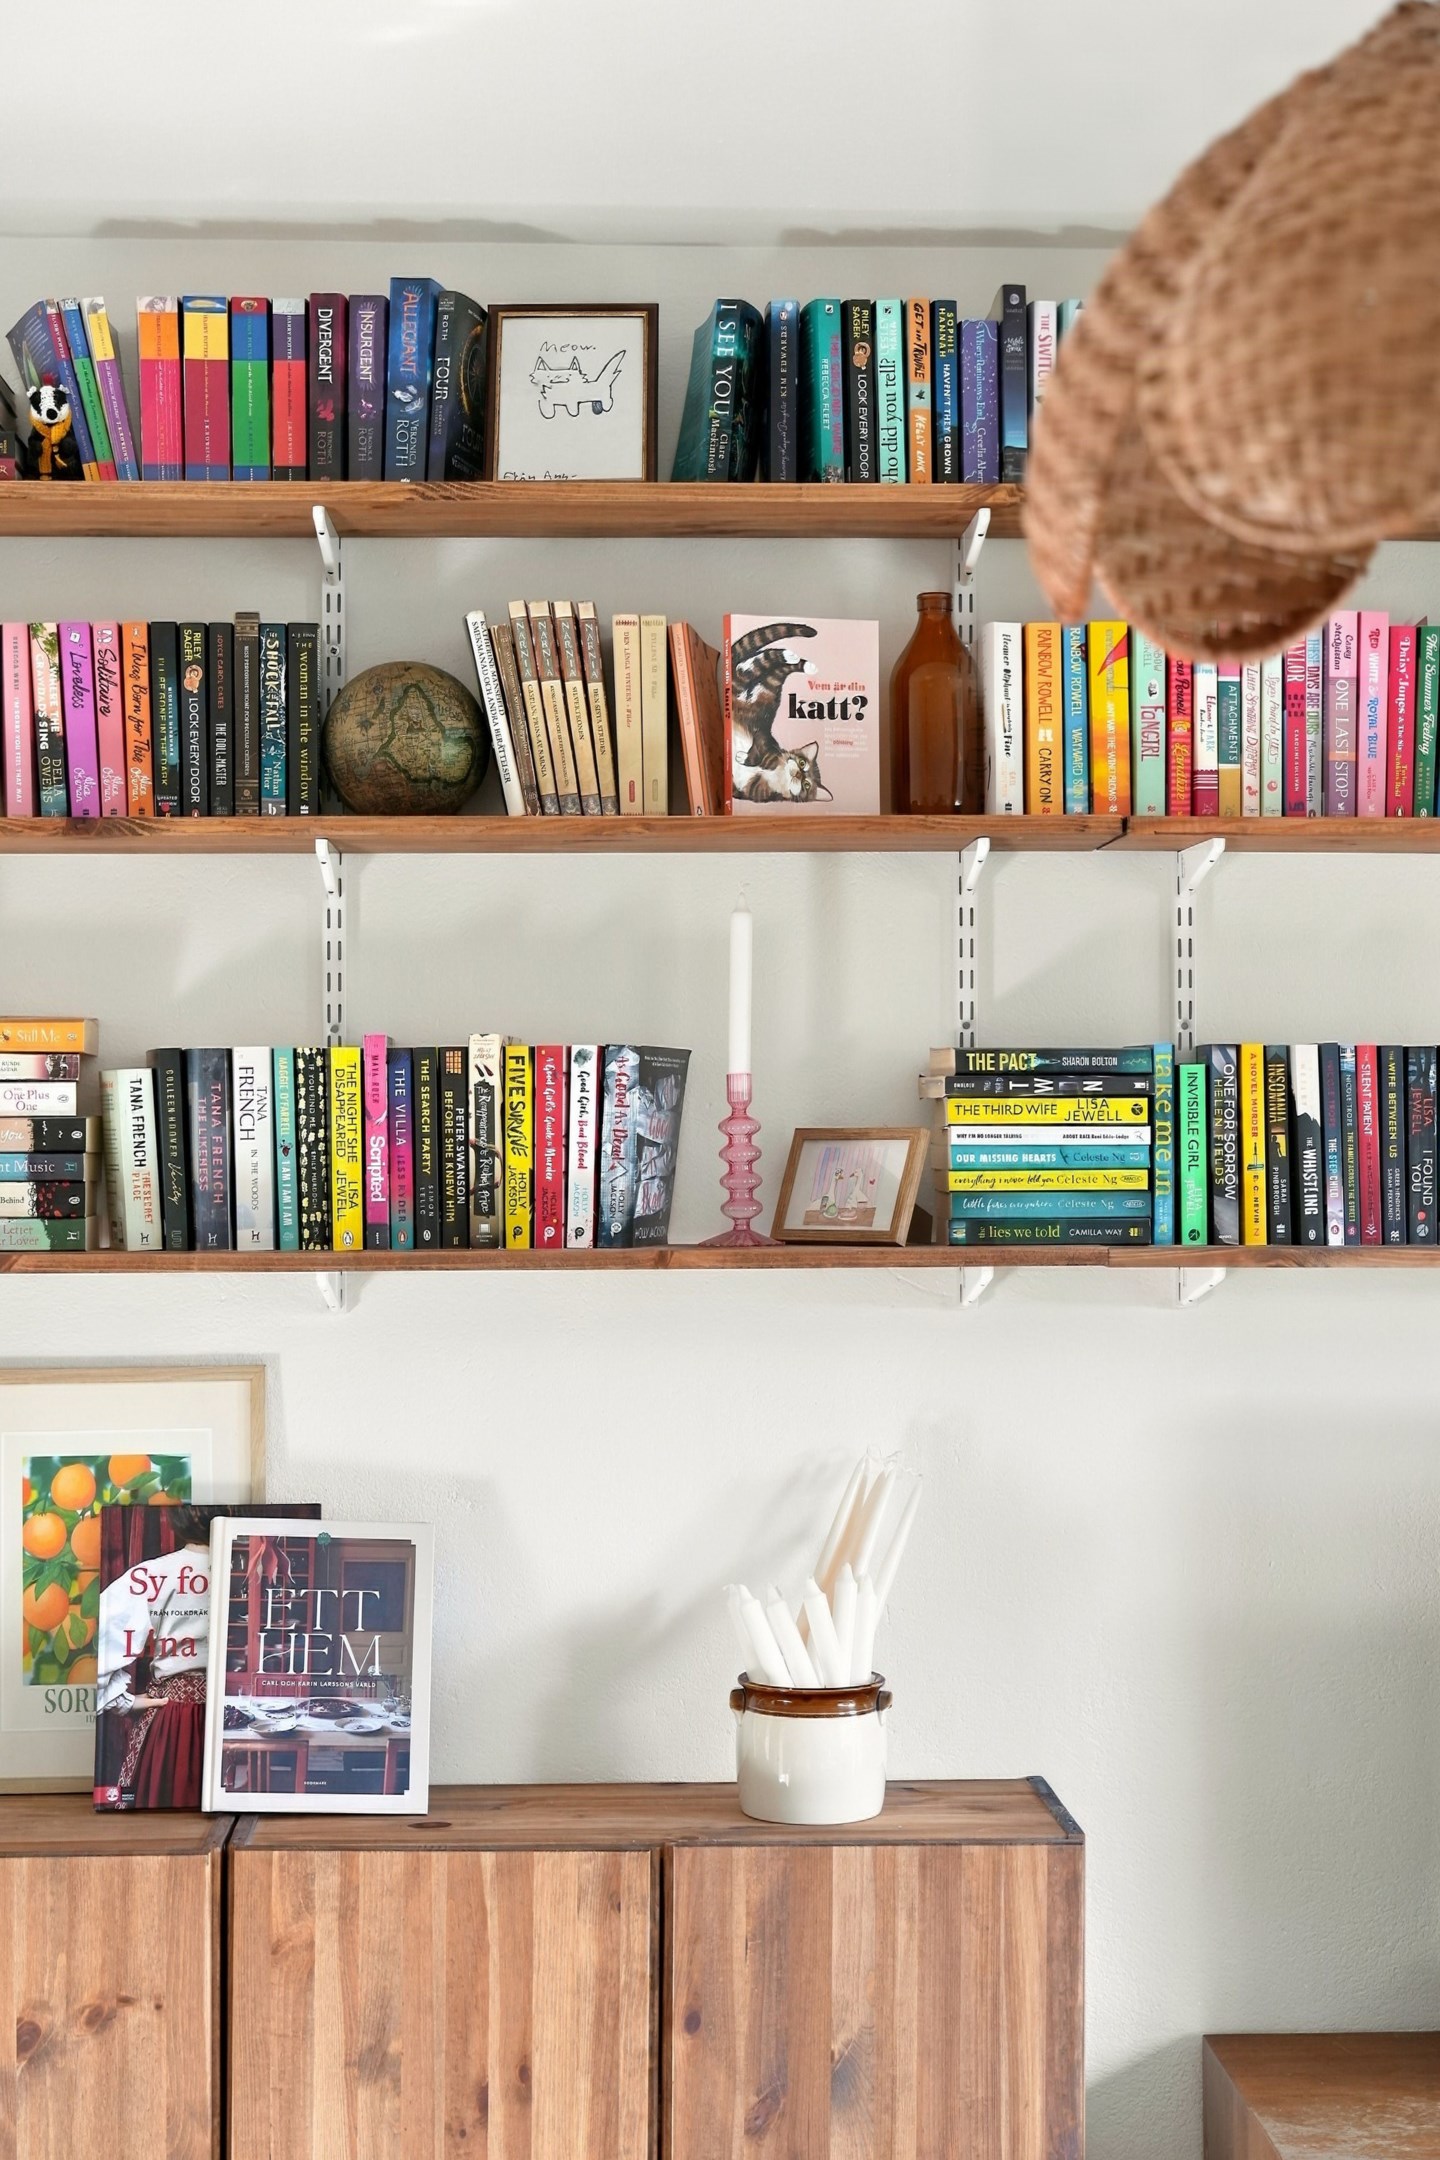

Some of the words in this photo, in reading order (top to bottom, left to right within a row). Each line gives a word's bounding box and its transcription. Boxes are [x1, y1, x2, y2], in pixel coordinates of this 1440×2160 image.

[861, 310, 869, 336] RILEY
[913, 303, 924, 325] GET
[318, 309, 333, 384] DIVERGENT
[359, 311, 375, 383] INSURGENT
[400, 292, 418, 375] ALLEGIANT
[718, 321, 736, 356] SEE
[435, 357, 450, 400] FOUR
[713, 366, 732, 416] YOU
[858, 374, 867, 405] LOCK
[859, 408, 868, 441] EVERY
[887, 392, 901, 422] you
[317, 431, 327, 465] ROTH
[396, 420, 408, 466] ROTH
[409, 420, 419, 466] VERONICA
[708, 419, 719, 474] Mackintosh
[719, 434, 728, 460] Clare
[882, 427, 899, 452] did
[860, 444, 869, 478] DOOR
[916, 450, 926, 472] LINK
[184, 630, 192, 661] SAGER
[193, 632, 201, 658] RILEY
[1038, 629, 1052, 678] RAINBOW
[1070, 628, 1082, 674] RAINBOW
[1369, 629, 1380, 648] RED
[1426, 634, 1437, 660] That
[265, 639, 280, 691] SHOCK
[1396, 637, 1410, 678] Daisy
[69, 652, 90, 708] Loveless
[97, 648, 118, 716] Solitaire
[299, 652, 310, 700] woman
[808, 680, 831, 691] Vem
[833, 682, 847, 691] är
[848, 682, 865, 692] din
[1423, 664, 1436, 713] Summer
[132, 684, 148, 714] Born
[300, 705, 312, 717] in
[788, 694, 868, 721] katt?
[1038, 682, 1052, 724] ROWELL
[1071, 678, 1082, 716] ROWELL
[1335, 680, 1349, 710] ONE
[1395, 678, 1408, 714] Jones
[51, 711, 59, 732] THE
[189, 698, 198, 729] LOCK
[216, 723, 226, 735] THE
[266, 701, 279, 730] FALL
[1228, 686, 1237, 761] ATTACHMENTS
[1368, 697, 1378, 730] ROYAL
[39, 722, 48, 750] SING
[190, 732, 199, 765] EVERY
[300, 723, 311, 743] the
[1335, 718, 1349, 756] LAST
[1368, 733, 1378, 758] BLUE
[1419, 714, 1434, 755] Feeling
[133, 739, 150, 763] This
[1039, 748, 1052, 784] CARRY
[1072, 728, 1083, 776] WAYWARD
[41, 756, 52, 802] OWENS
[52, 759, 62, 796] DELIA
[191, 769, 200, 802] DOOR
[272, 762, 281, 795] Nathan
[300, 749, 311, 801] window
[1173, 742, 1190, 800] Landline
[1335, 762, 1348, 797] STOP
[1040, 788, 1052, 803] ON
[346, 1063, 356, 1087] THE
[421, 1059, 429, 1081] THE
[509, 1056, 525, 1097] FIVE
[966, 1054, 995, 1070] THE
[999, 1053, 1037, 1070] PACT
[1062, 1057, 1089, 1066] SHARON
[27, 1090, 49, 1100] Plus
[129, 1078, 143, 1111] TANA
[395, 1068, 405, 1096] THE
[1156, 1053, 1172, 1112] take
[1223, 1064, 1233, 1096] ONE
[1269, 1064, 1285, 1122] INSOMNIA
[1361, 1064, 1372, 1098] SILENT
[16, 1101, 37, 1111] One
[211, 1083, 222, 1127] TANA
[239, 1067, 255, 1141] FRENCH
[257, 1086, 267, 1121] TANA
[336, 1069, 345, 1157] DISAPPEARED
[347, 1092, 357, 1135] NIGHT
[421, 1087, 430, 1132] SEARCH
[444, 1091, 453, 1134] BEFORE
[955, 1105, 980, 1115] THE
[985, 1105, 1023, 1115] THIRD
[1026, 1104, 1057, 1114] WIFE
[1064, 1110, 1122, 1121] JEWELL
[1078, 1098, 1109, 1109] LISA
[1187, 1072, 1198, 1135] INVISIBLE
[1224, 1100, 1234, 1130] FOR
[1363, 1101, 1372, 1135] PATIENT
[1411, 1087, 1422, 1135] JEWELL
[1423, 1098, 1432, 1126] LISA
[132, 1116, 146, 1167] FRENCH
[396, 1104, 406, 1146] VILLA
[456, 1108, 464, 1141] PETER
[507, 1101, 528, 1157] SURVIVE
[1156, 1120, 1171, 1162] me
[199, 1129, 208, 1192] LIKENESS
[348, 1138, 357, 1163] SHE
[422, 1138, 430, 1175] PARTY
[445, 1138, 453, 1158] SHE
[957, 1154, 975, 1163] OUR
[980, 1154, 1018, 1163] MISSING
[1022, 1153, 1056, 1162] HEARTS
[1188, 1140, 1199, 1171] GIRL
[1215, 1134, 1223, 1185] FIELDS
[14, 1160, 55, 1173] Music
[213, 1136, 223, 1204] FRENCH
[367, 1136, 385, 1202] Scripted
[445, 1163, 453, 1195] KNEW
[456, 1146, 465, 1204] SWANSON
[1057, 1172, 1098, 1184] Celeste
[1156, 1168, 1171, 1197] in
[1225, 1134, 1236, 1200] SORROW
[1303, 1149, 1317, 1215] WHISTLING
[1412, 1164, 1421, 1192] YOU
[1423, 1158, 1432, 1206] FOUND
[168, 1163, 182, 1206] Verity
[336, 1170, 346, 1221] JEWELL
[348, 1181, 358, 1209] LISA
[508, 1166, 517, 1216] JACKSON
[518, 1172, 526, 1208] HOLLY
[989, 1225, 1010, 1237] lies
[1035, 1225, 1060, 1237] told
[129, 1567, 166, 1602] Sy
[264, 1589, 381, 1631] ETT
[123, 1629, 197, 1658] Lina
[256, 1633, 383, 1676] HEM
